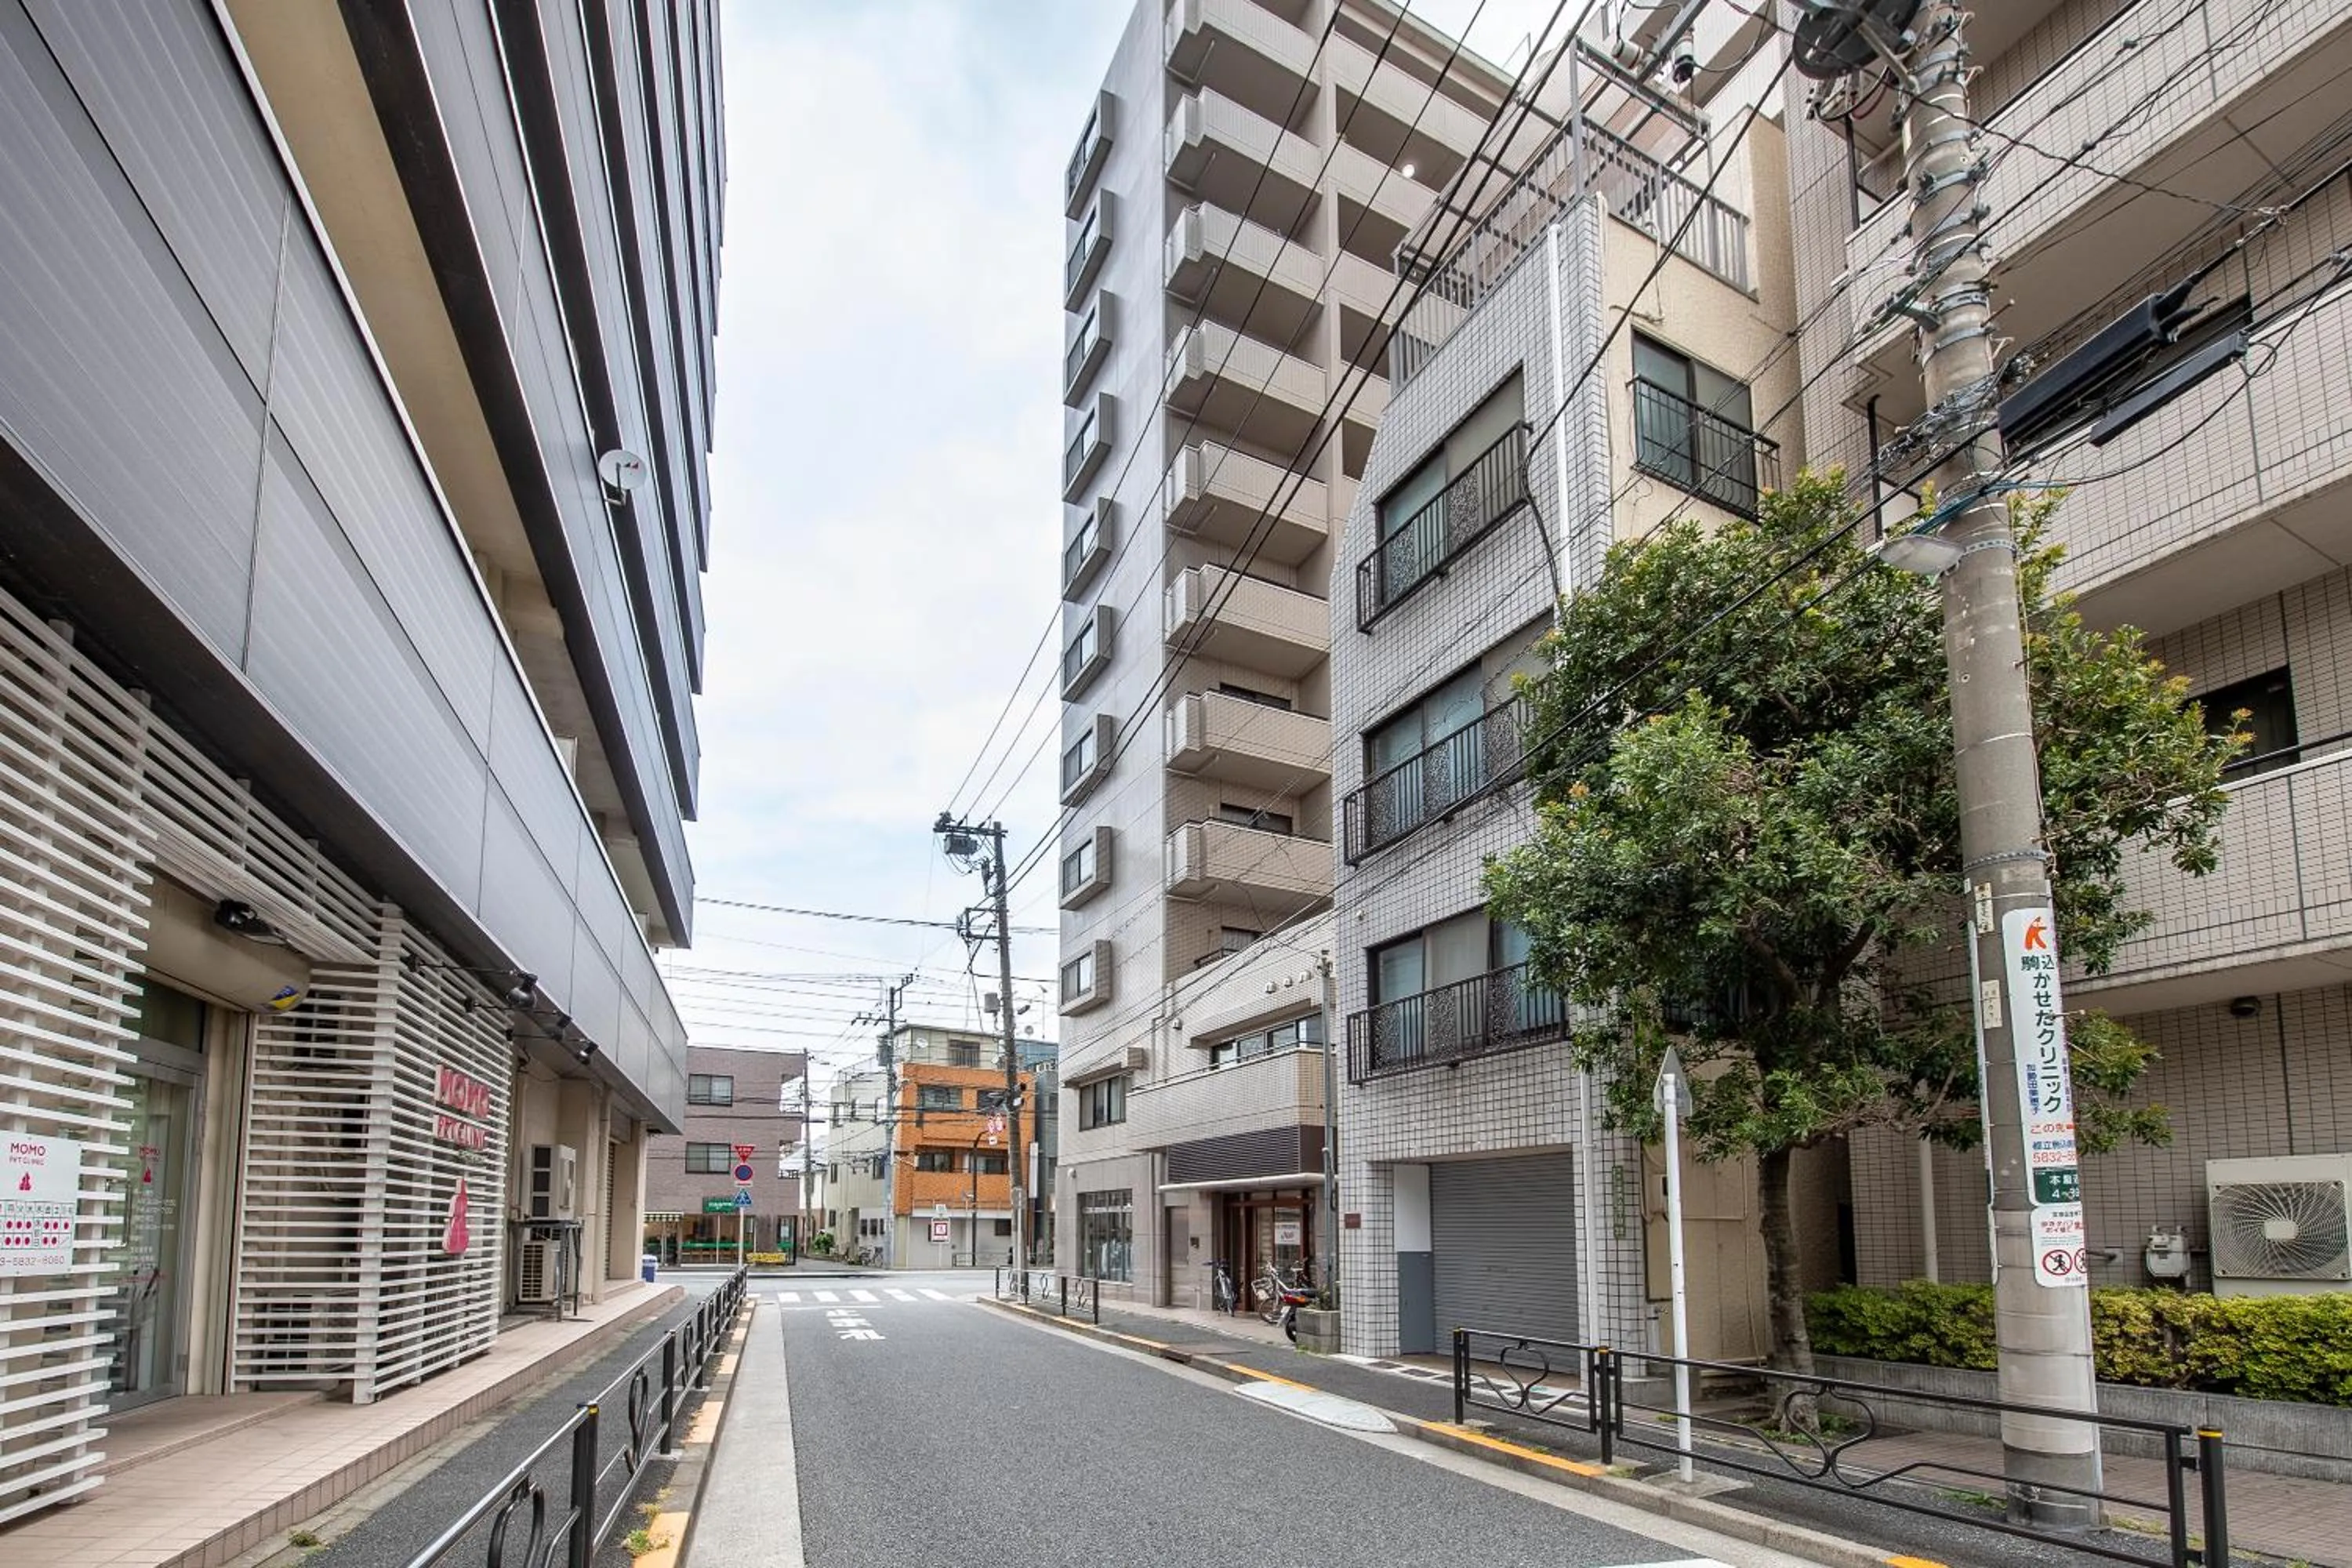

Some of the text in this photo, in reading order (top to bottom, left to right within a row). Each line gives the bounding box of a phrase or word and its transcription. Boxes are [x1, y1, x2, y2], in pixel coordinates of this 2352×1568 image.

[2020, 954, 2055, 971] 駒込
[2033, 973, 2062, 1113] かせだクリニック
[434, 1065, 489, 1120] MOMO
[10, 1142, 46, 1156] MOMO
[826, 1308, 886, 1341] 止まれ
